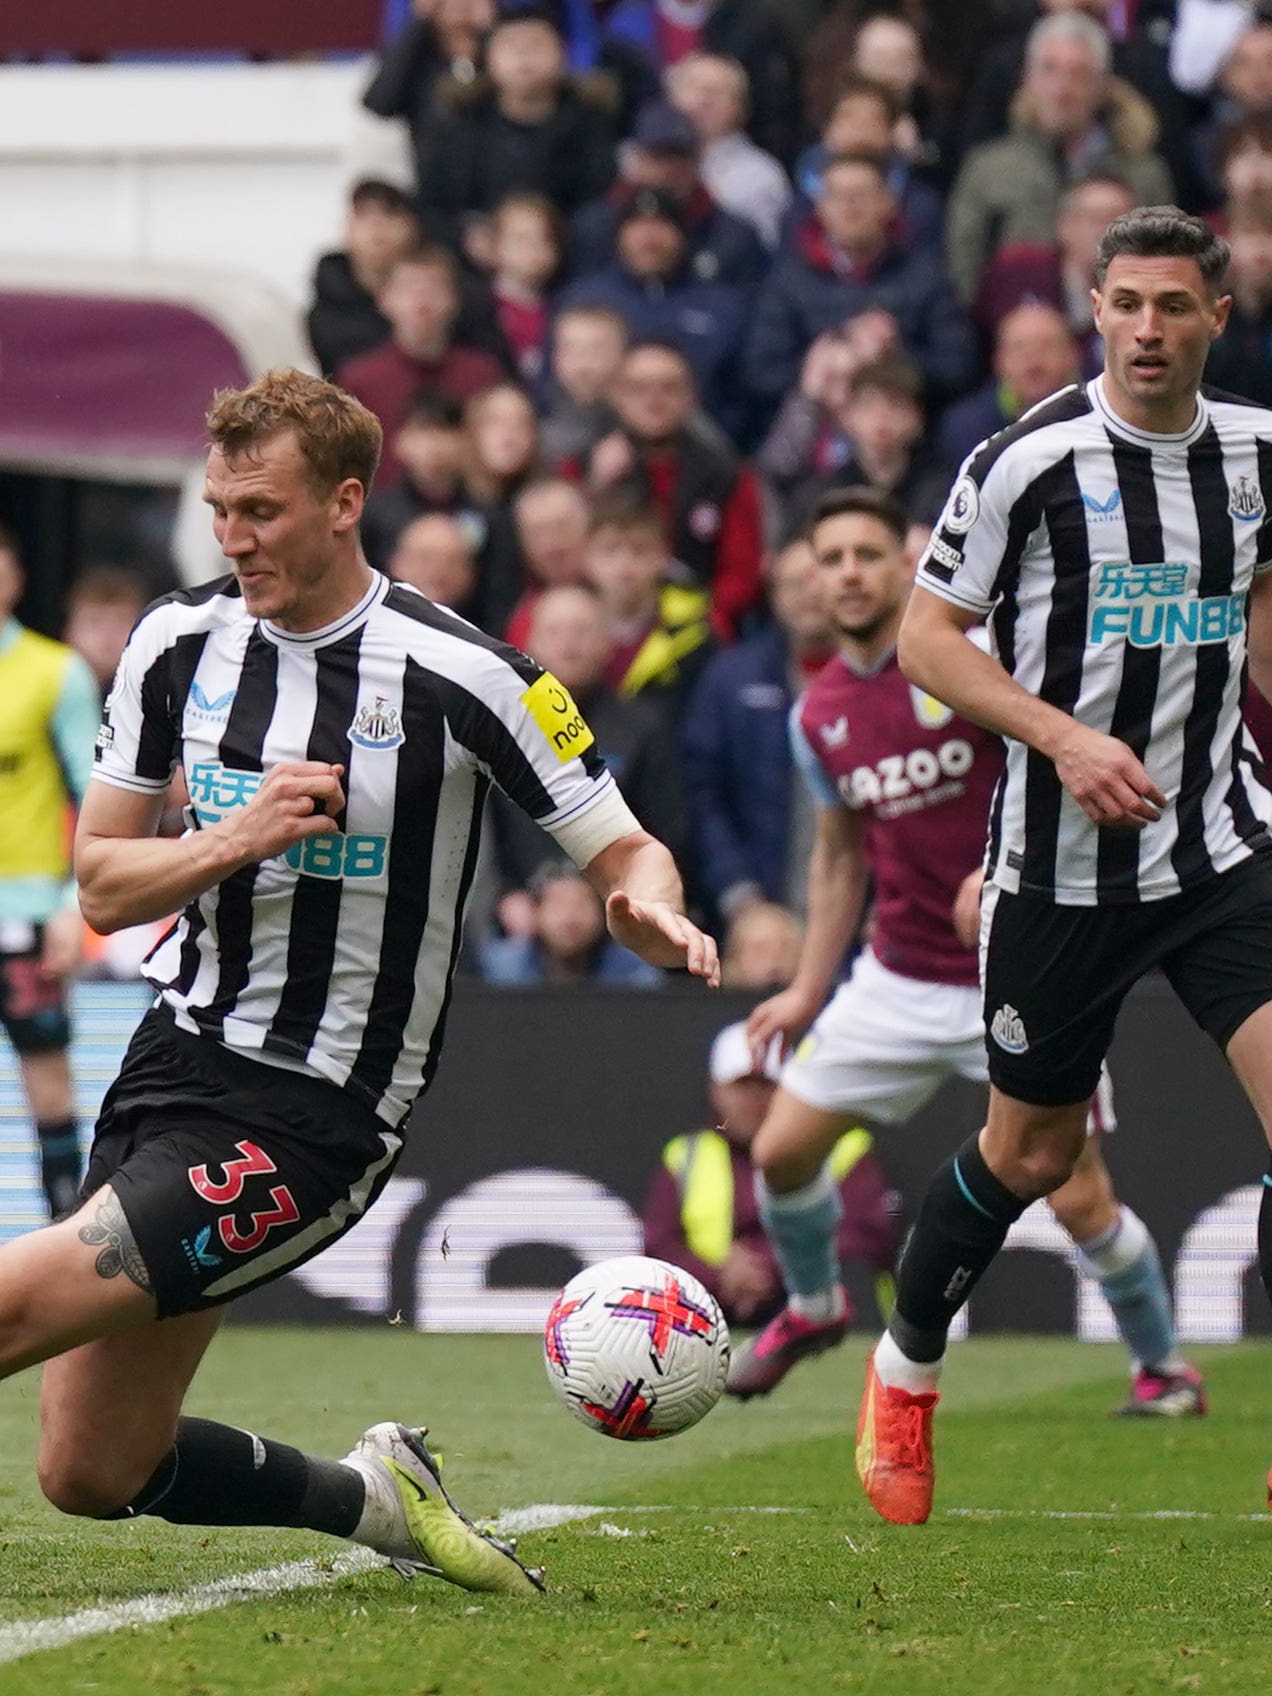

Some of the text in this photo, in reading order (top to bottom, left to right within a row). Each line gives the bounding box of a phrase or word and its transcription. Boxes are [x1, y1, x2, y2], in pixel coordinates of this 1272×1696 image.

[1095, 564, 1189, 598] 乐天堂
[1090, 595, 1247, 646] FUN88
[188, 1140, 301, 1254] 33
